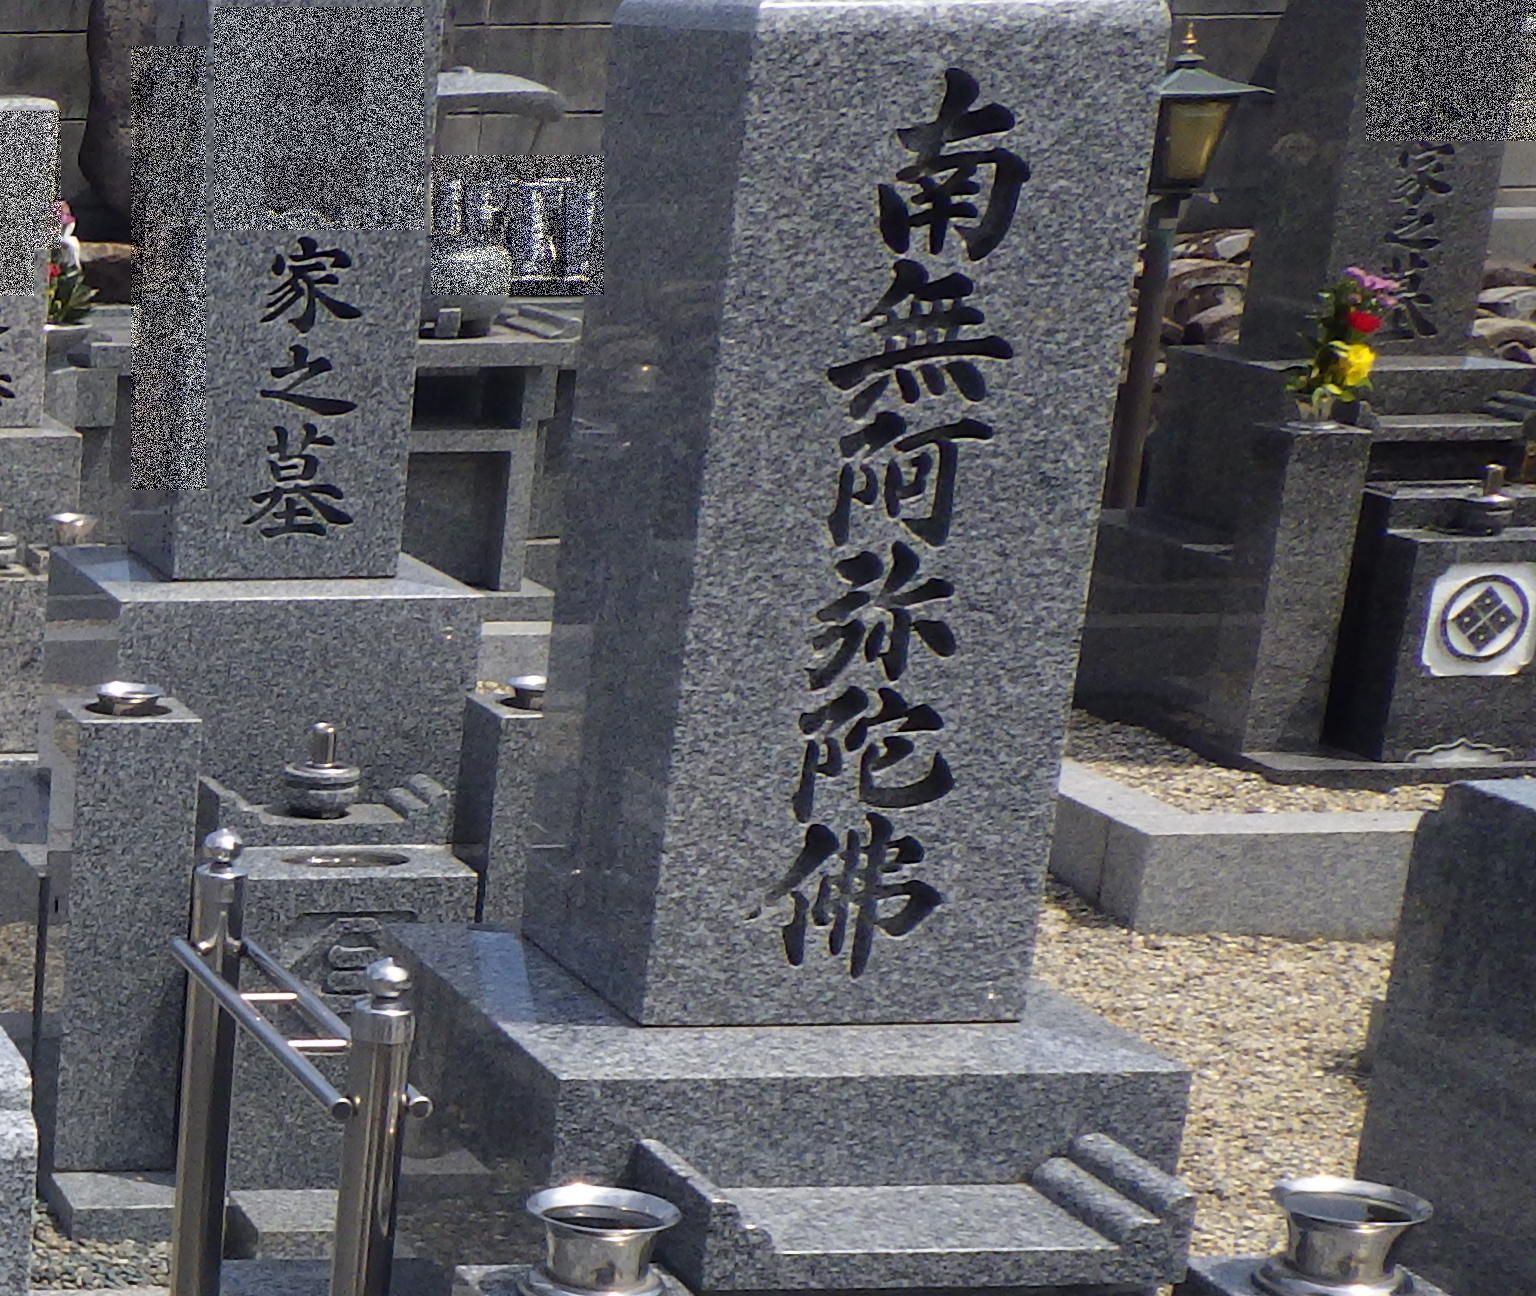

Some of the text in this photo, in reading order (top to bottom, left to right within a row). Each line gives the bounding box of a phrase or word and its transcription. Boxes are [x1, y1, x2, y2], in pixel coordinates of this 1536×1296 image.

[243, 237, 363, 538] 家之墓
[744, 67, 1030, 979] 南無阿弥陀佛
